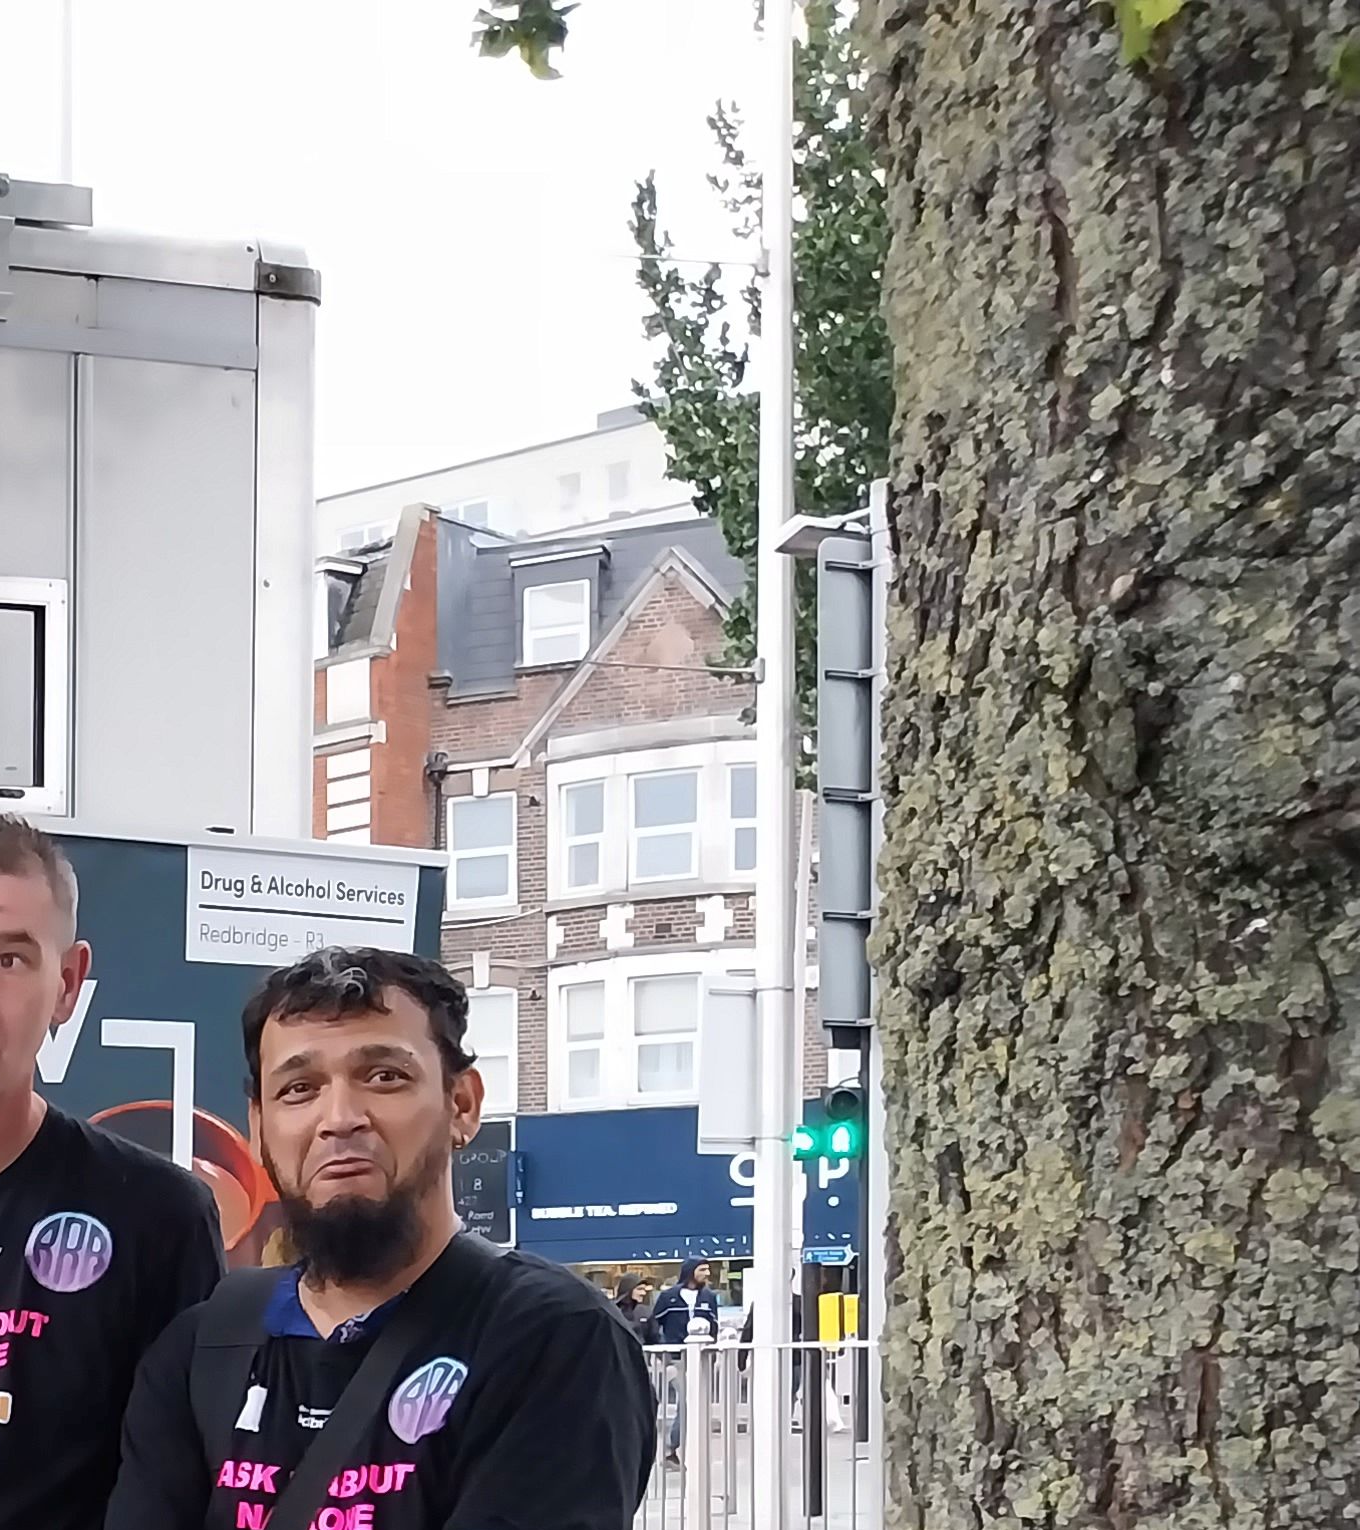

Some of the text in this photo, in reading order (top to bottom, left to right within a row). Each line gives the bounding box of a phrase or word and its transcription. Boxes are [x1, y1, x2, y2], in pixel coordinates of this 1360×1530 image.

[201, 870, 405, 906] Drug & Alcohol Services
[199, 923, 289, 951] Redbridge
[305, 931, 325, 950] R3
[217, 1460, 281, 1494] ASK
